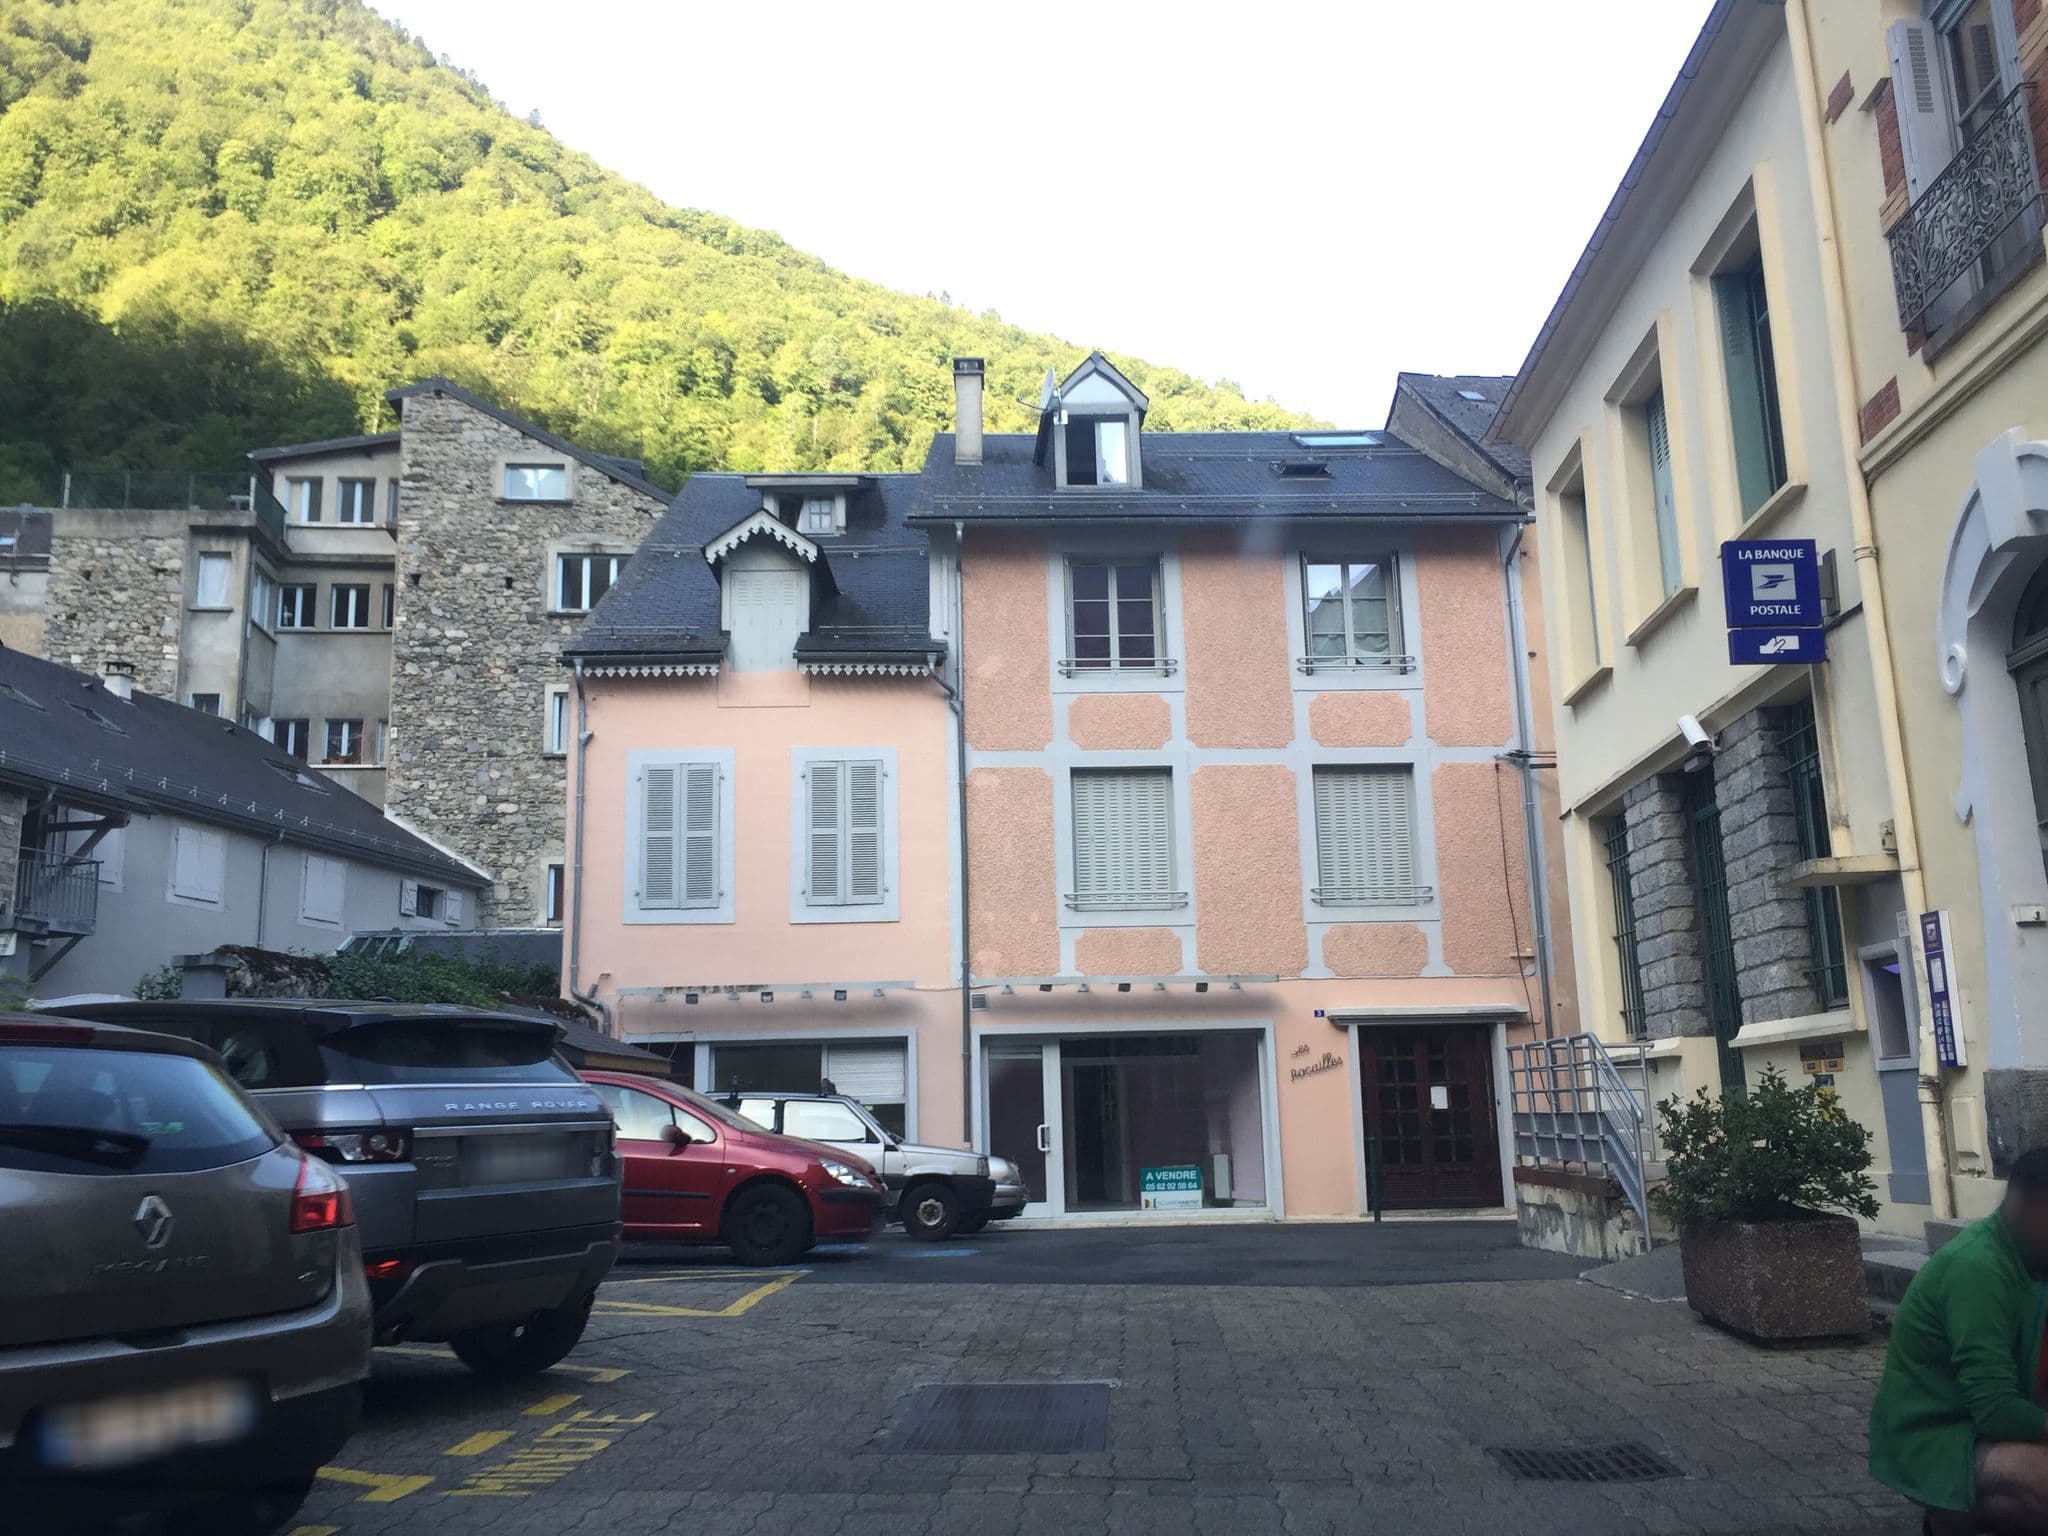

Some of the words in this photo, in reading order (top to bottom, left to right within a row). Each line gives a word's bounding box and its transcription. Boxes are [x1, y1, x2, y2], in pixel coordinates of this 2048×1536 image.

[1738, 550, 1753, 560] LA
[1755, 548, 1805, 560] BANQUE
[1750, 604, 1802, 616] POSTALE
[444, 1101, 520, 1112] RANGE
[531, 1099, 588, 1109] ROVER
[1146, 1172, 1154, 1181] A
[1155, 1171, 1197, 1180] VENDRE
[1146, 1183, 1155, 1191] 05
[439, 1410, 656, 1497] MINUTE
